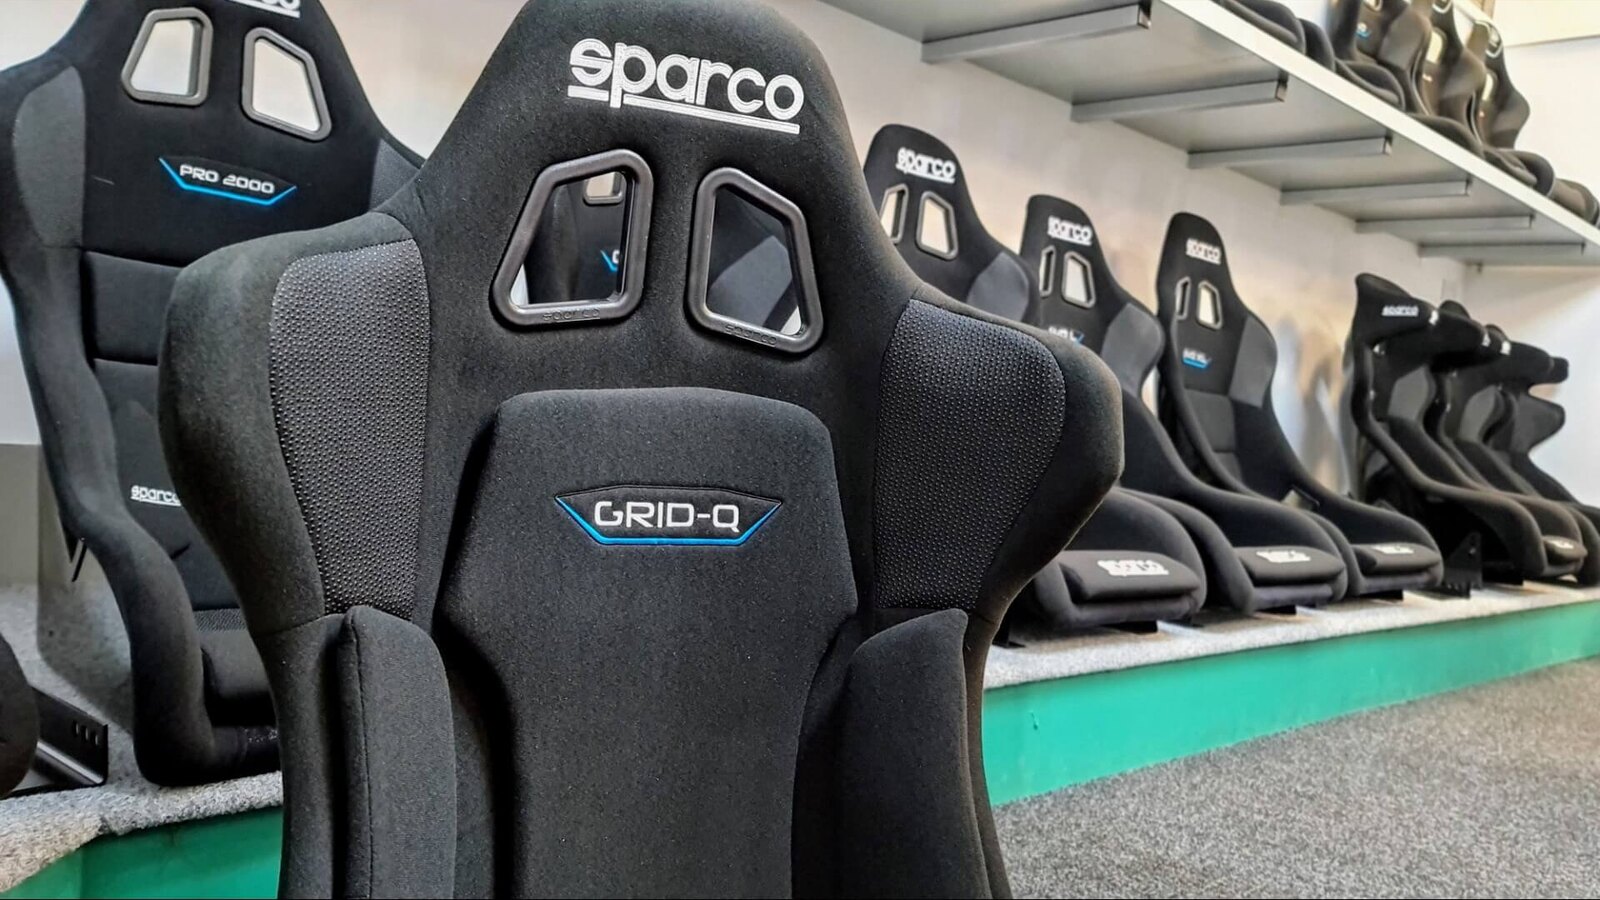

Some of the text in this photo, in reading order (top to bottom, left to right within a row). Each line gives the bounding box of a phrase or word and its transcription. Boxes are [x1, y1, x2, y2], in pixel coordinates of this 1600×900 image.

[568, 38, 804, 124] sparco
[180, 164, 275, 194] PRO 2000
[896, 146, 956, 181] sparco
[1047, 215, 1092, 244] sparco
[594, 501, 740, 533] GRID-Q
